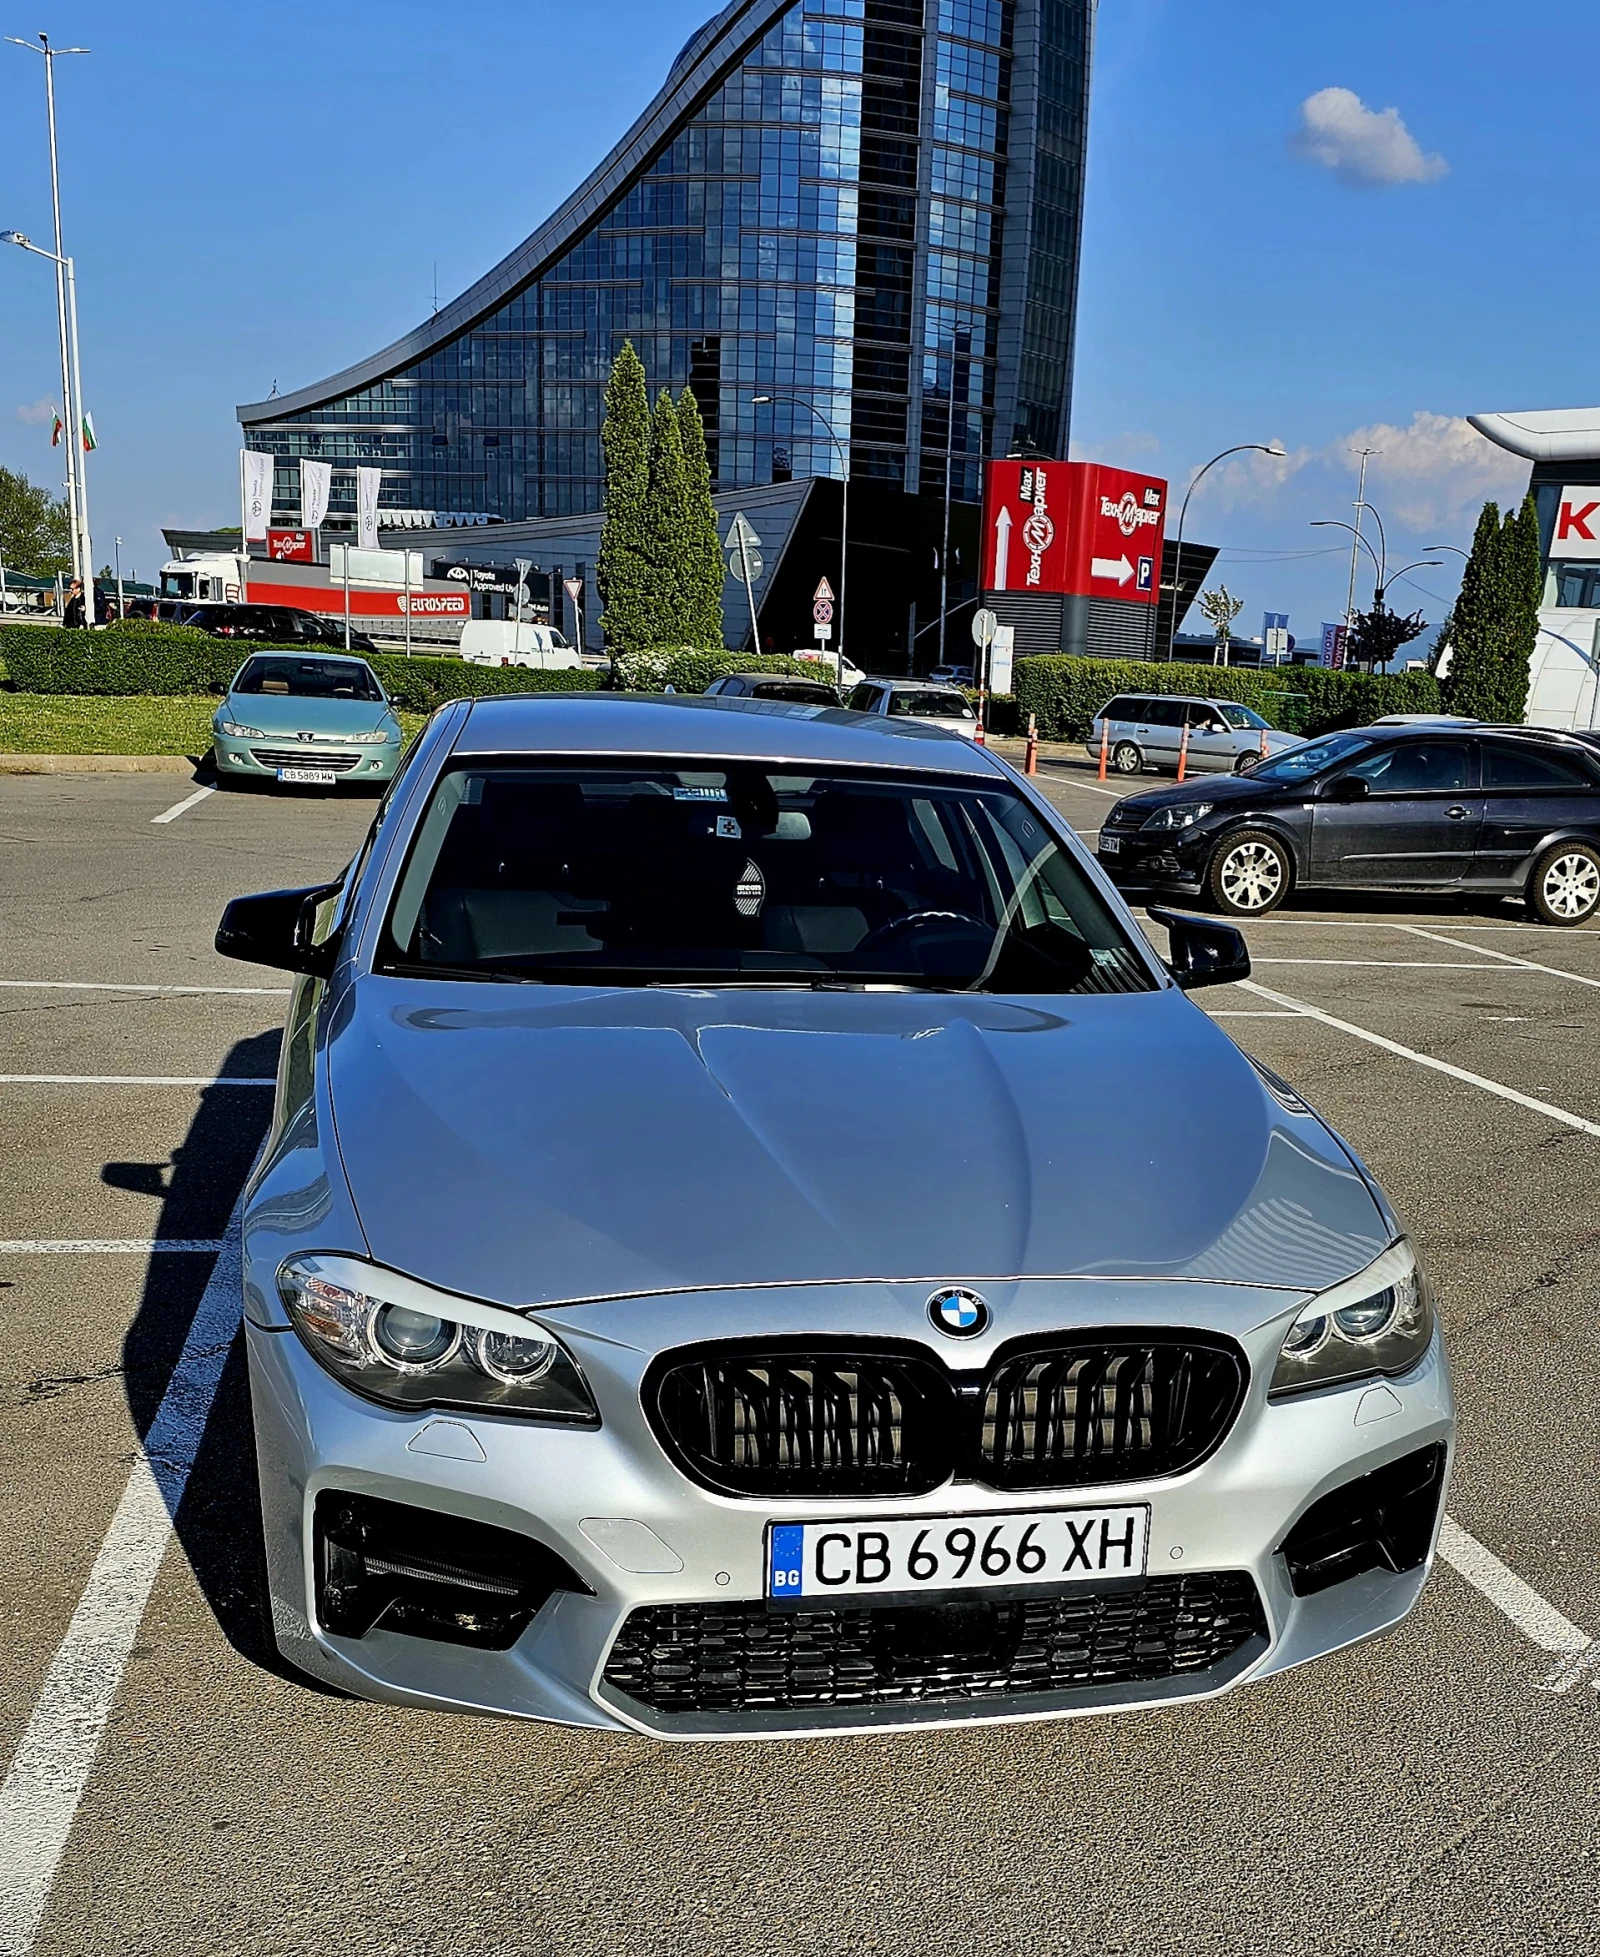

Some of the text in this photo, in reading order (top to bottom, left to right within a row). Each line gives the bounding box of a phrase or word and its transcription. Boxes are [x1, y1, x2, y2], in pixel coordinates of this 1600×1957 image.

[1020, 470, 1033, 501] Max
[1144, 488, 1160, 506] Max
[473, 569, 496, 582] Toyota
[1140, 562, 1150, 585] P
[473, 582, 505, 592] Approved
[410, 597, 465, 612] EUROSPEED
[1323, 629, 1334, 666] TOYOTA
[815, 1516, 1135, 1586] CB 6966 XH
[774, 1570, 799, 1587] BG
